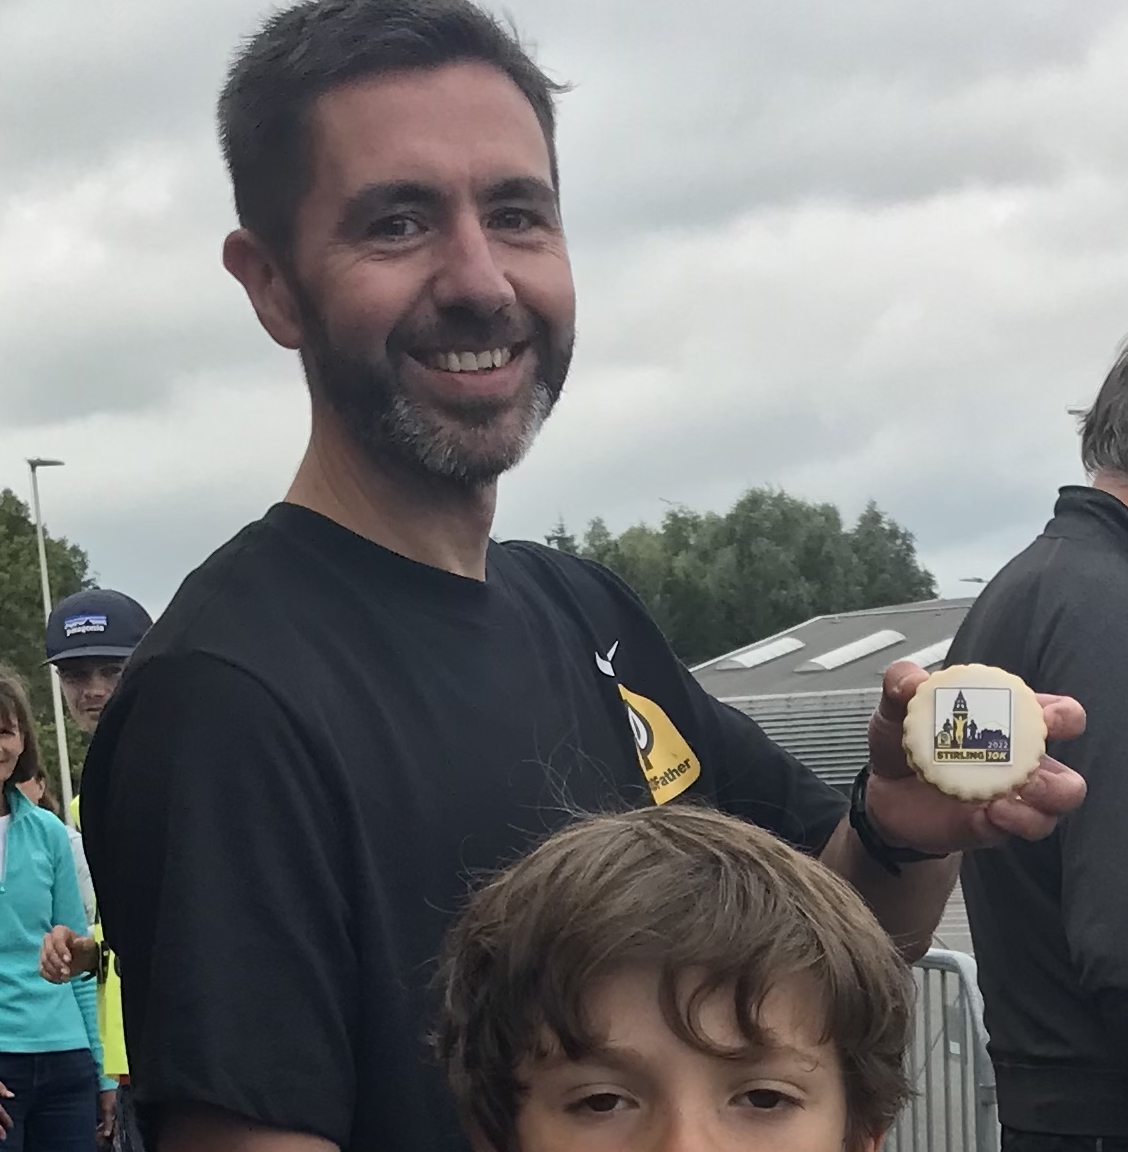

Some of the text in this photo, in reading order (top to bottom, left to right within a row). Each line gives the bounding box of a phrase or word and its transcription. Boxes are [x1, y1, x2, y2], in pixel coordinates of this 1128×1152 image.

[66, 625, 105, 637] patagonia
[987, 741, 1008, 749] 2022
[937, 751, 1008, 760] STIRLING 10K
